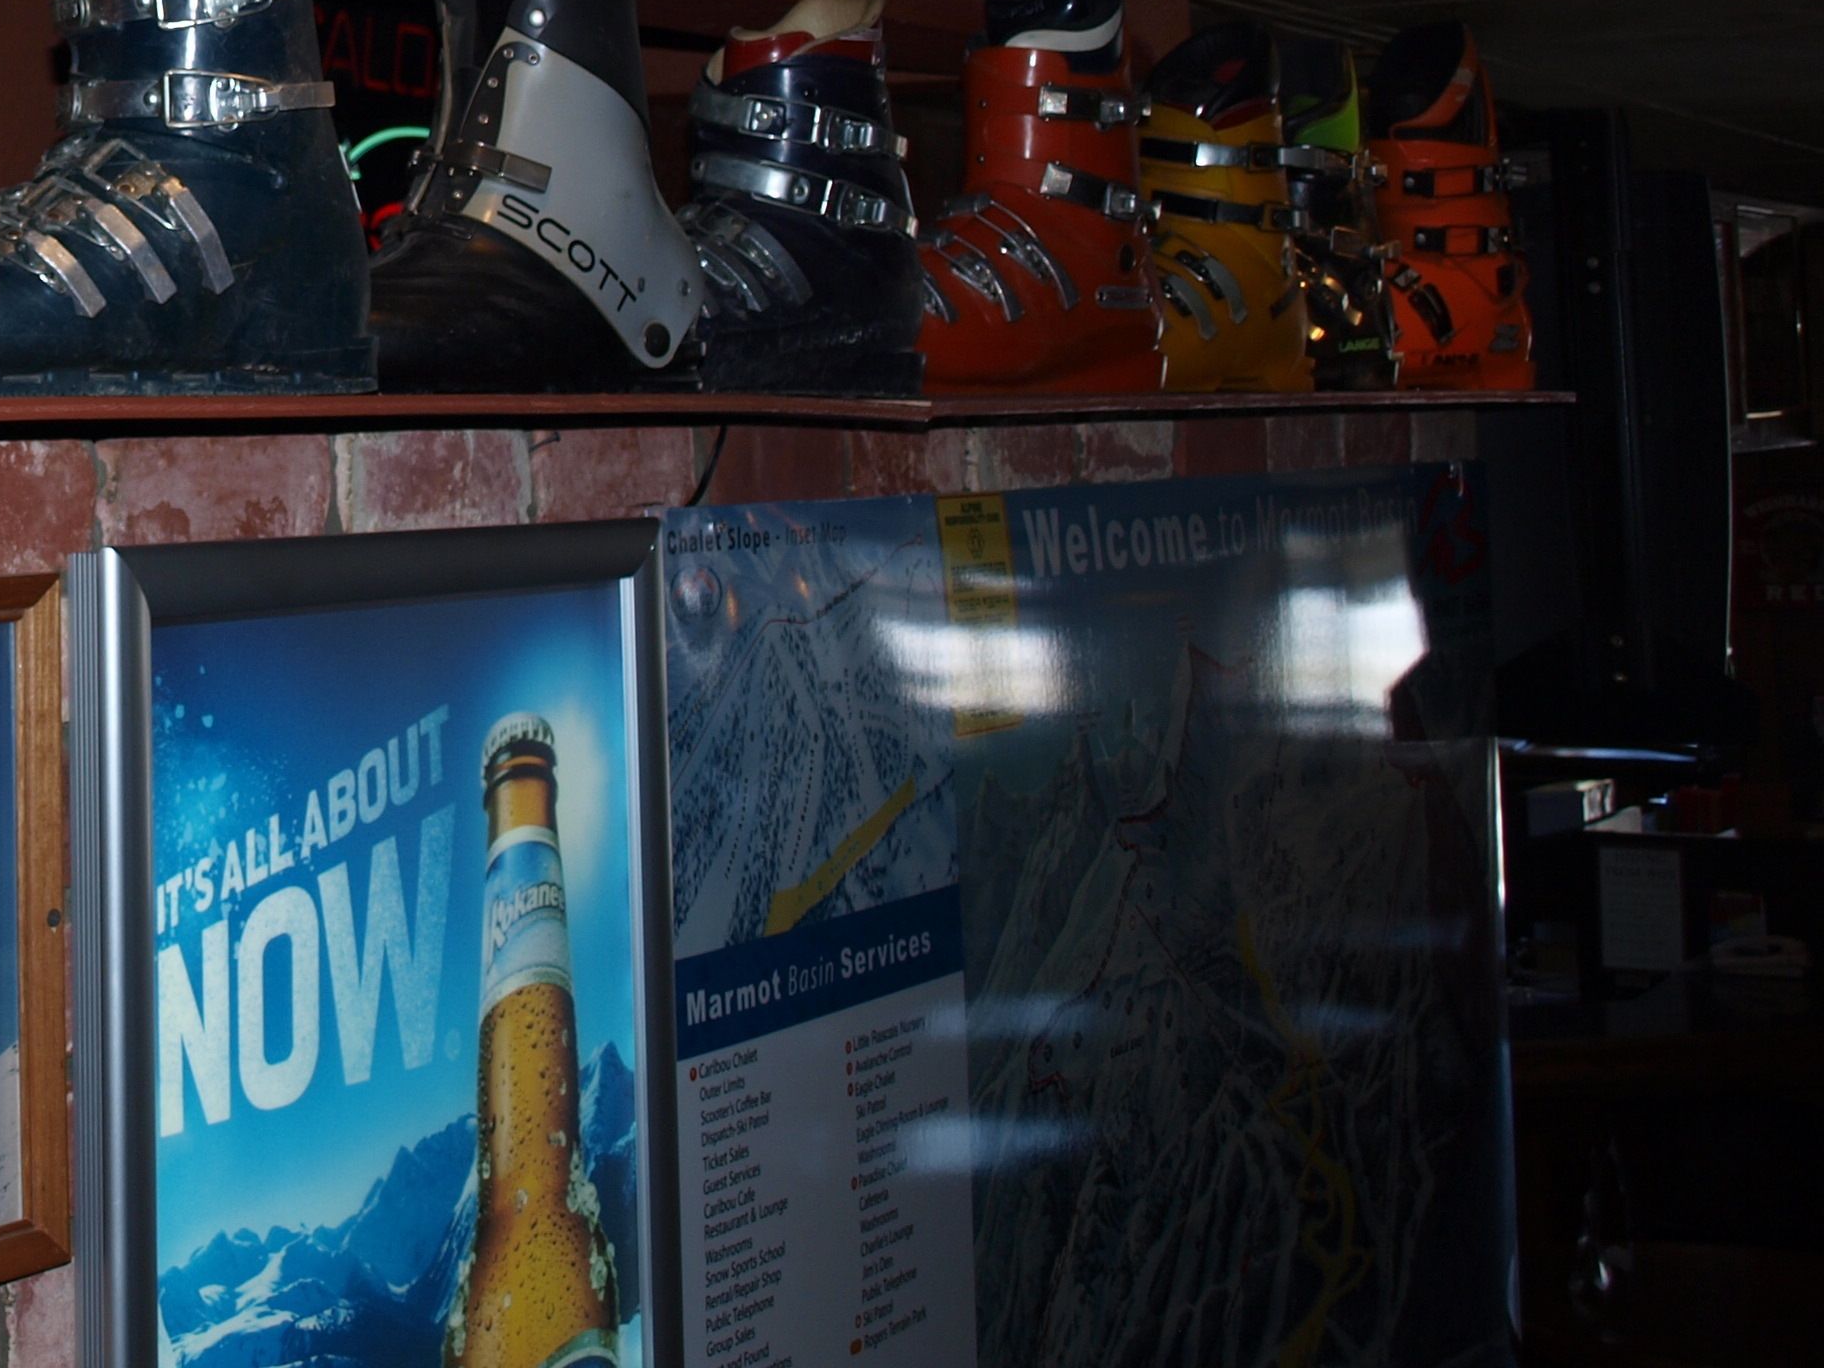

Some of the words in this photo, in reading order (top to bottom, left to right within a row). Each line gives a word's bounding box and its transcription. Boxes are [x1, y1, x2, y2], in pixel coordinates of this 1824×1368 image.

[497, 194, 637, 312] SCOTT
[666, 525, 722, 555] Chalet
[728, 525, 770, 555] Slope
[1022, 504, 1208, 578] Welcome
[1215, 506, 1247, 556] to
[1256, 494, 1349, 553] Marmot
[156, 855, 215, 935] IT'S
[220, 813, 294, 902] ALL
[301, 704, 450, 859] ABOUT
[687, 968, 781, 1026] Marmot
[788, 955, 835, 997] Basin
[840, 931, 932, 979] Services
[699, 1059, 731, 1079] Caribou
[733, 1049, 757, 1068] Chalet
[700, 1084, 721, 1101] Outer
[723, 1077, 745, 1094] Limits
[855, 1080, 873, 1098] Eagle
[701, 1102, 735, 1126] Scooter's
[736, 1095, 759, 1113] Coffee
[760, 1091, 772, 1105] Bar
[749, 1109, 769, 1130] Patrol
[856, 1104, 865, 1120] Ski
[867, 1094, 886, 1114] Patrol
[702, 1152, 727, 1173] Ticket
[729, 1144, 750, 1163] Sales
[703, 1176, 727, 1195] Guest
[729, 1164, 761, 1186] Services
[704, 1198, 736, 1219] Caribou
[704, 1212, 749, 1239] Restaurant
[759, 1198, 788, 1219] Lounge
[704, 1237, 752, 1264] Washrooms
[706, 1268, 729, 1288] Snow
[731, 1257, 757, 1278] Sports
[759, 1240, 785, 1266] School
[762, 1270, 782, 1288] Shop
[706, 1311, 731, 1333] Public
[733, 1296, 774, 1322] Telephone
[707, 1337, 733, 1357] Group
[735, 1326, 755, 1346] Sales
[744, 1341, 769, 1366] Found
